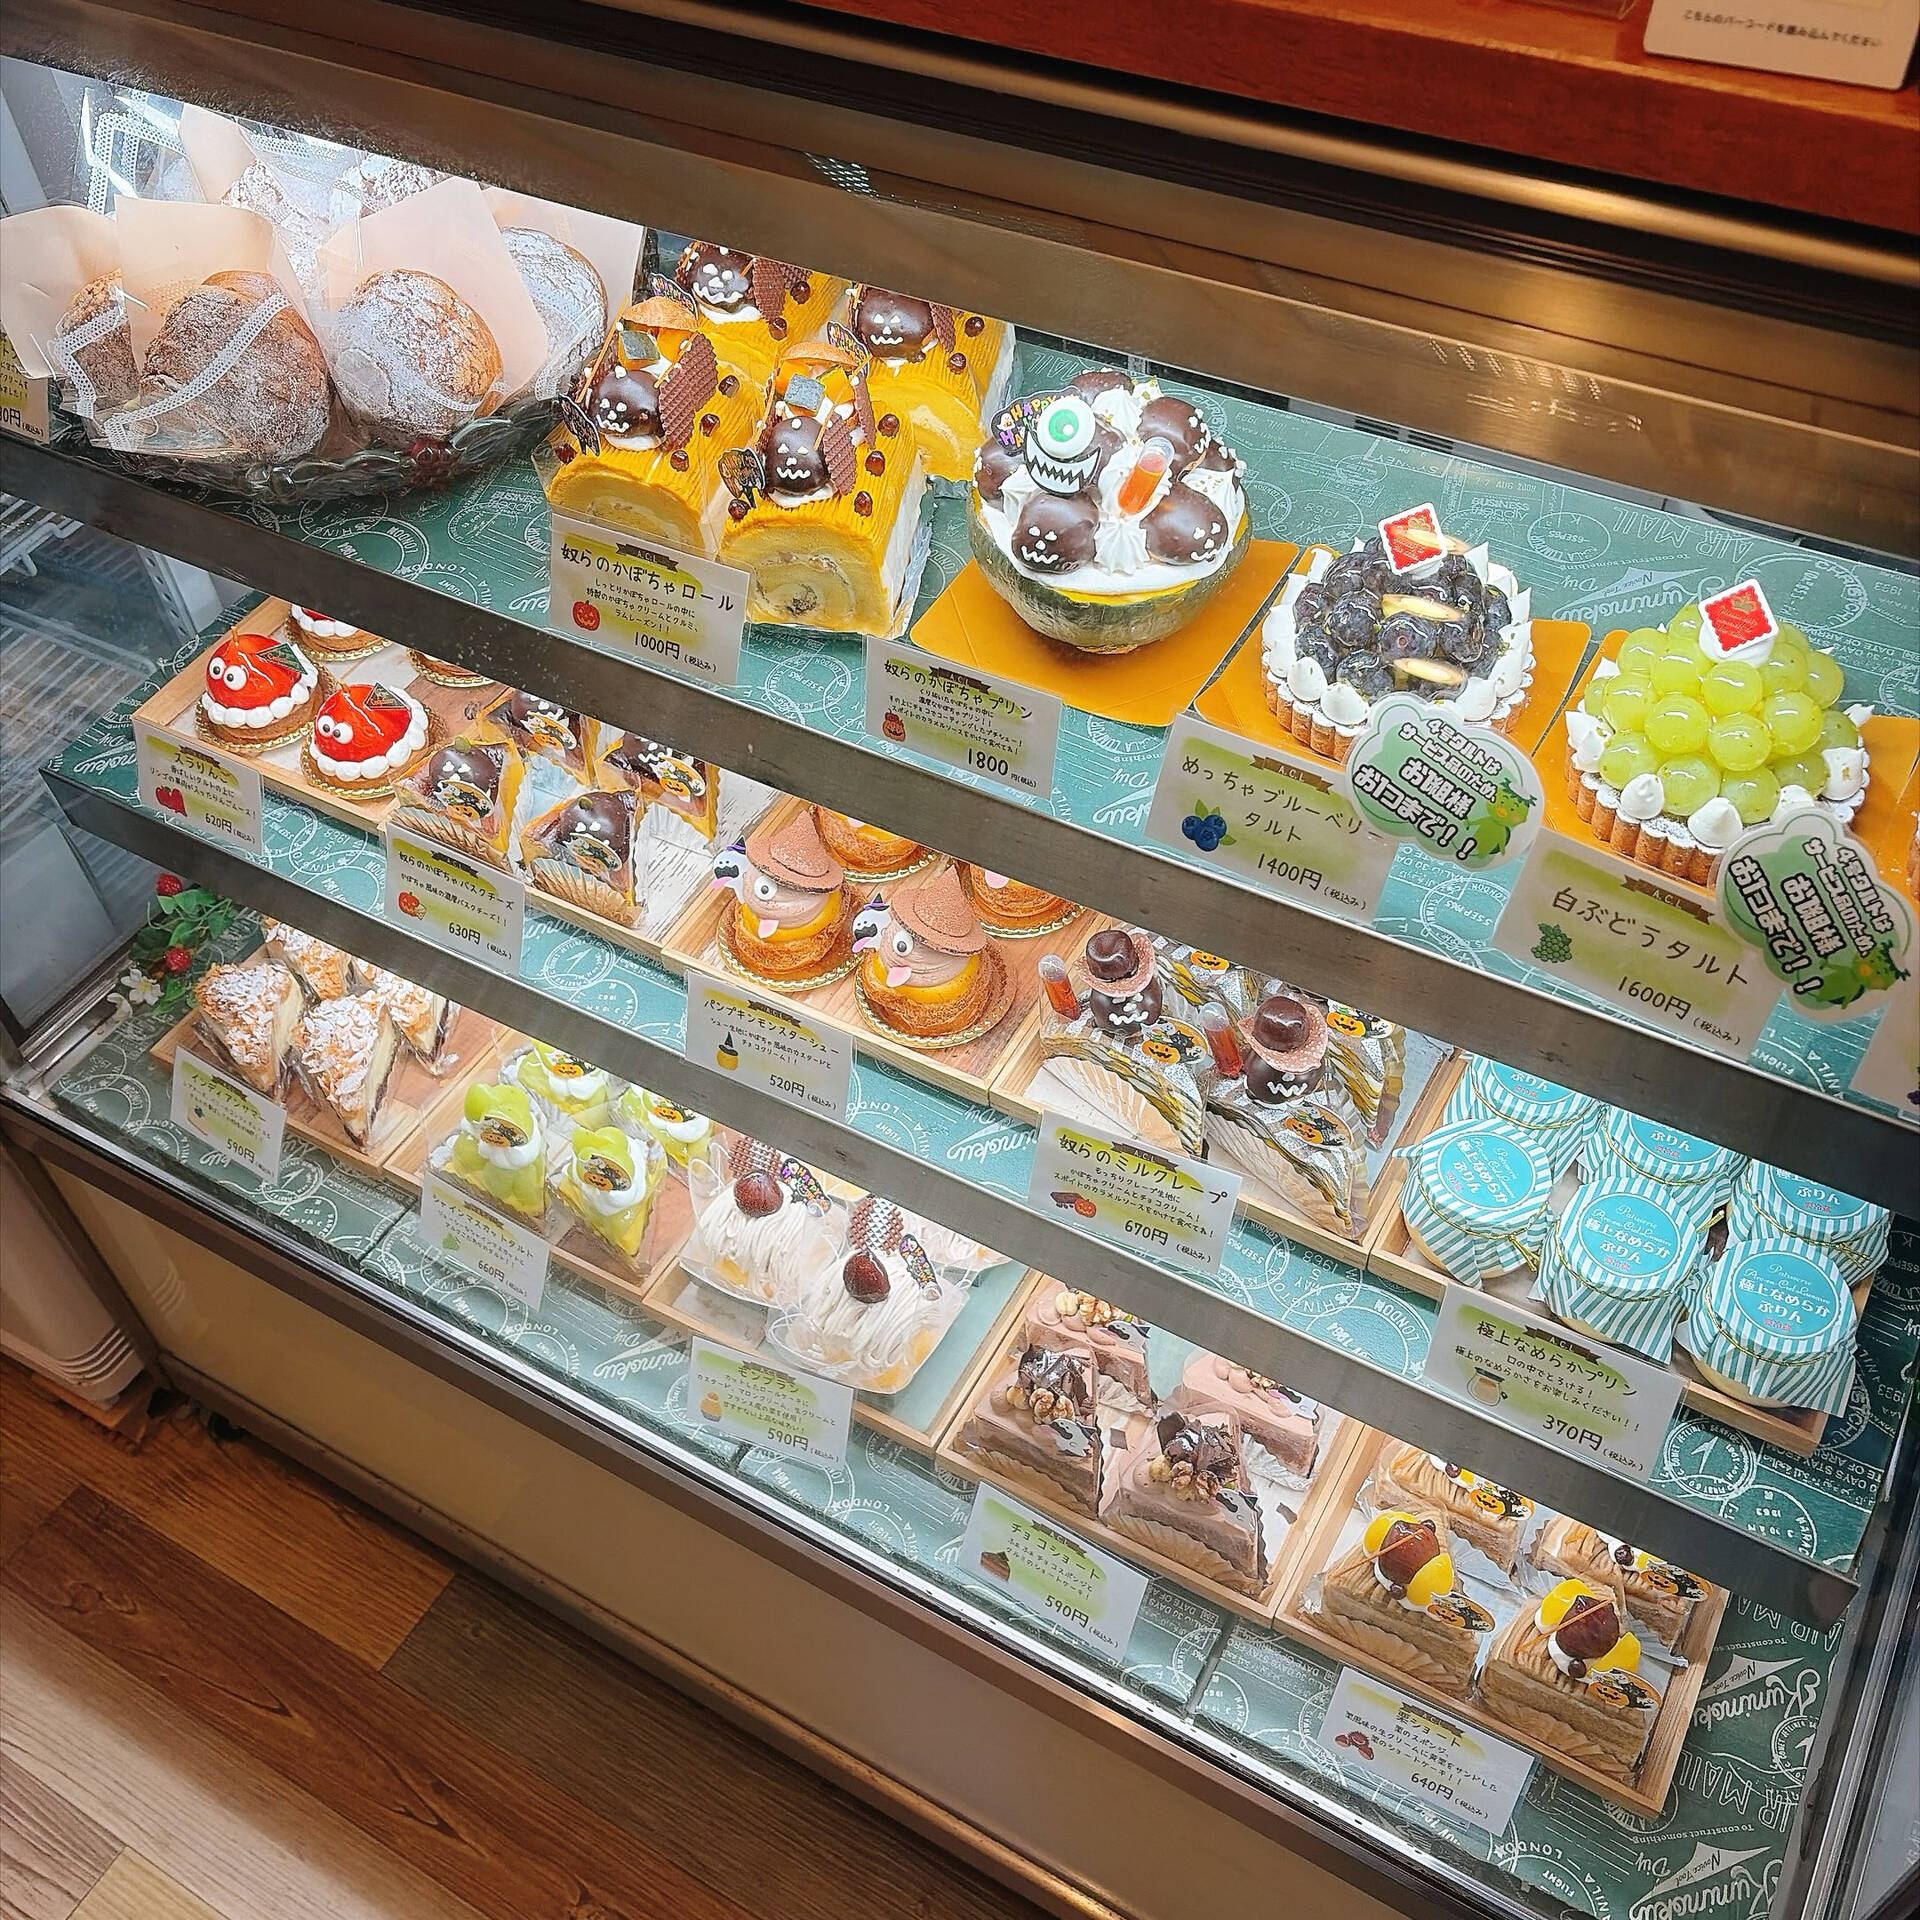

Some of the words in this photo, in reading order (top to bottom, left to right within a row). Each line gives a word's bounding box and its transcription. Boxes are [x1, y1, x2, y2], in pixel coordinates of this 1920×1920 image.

[1612, 506, 1689, 549] MAIL
[561, 543, 734, 611] 奴らのかぼちゃロール
[1560, 574, 1598, 592] Diy
[594, 578, 696, 619] しっとりかぼちゃロールの中に
[634, 632, 680, 660] 1000円
[884, 660, 1033, 719] 奴らのかぼちゃプリン
[967, 748, 1009, 776] 1800
[1398, 722, 1498, 804] サービス品のため、
[1426, 718, 1503, 777] 4号タルトは
[175, 752, 230, 784] スラりんご
[1182, 755, 1385, 840] めっちゃブルーベリー
[205, 813, 232, 833] 620円
[1244, 811, 1302, 844] タルト
[399, 851, 515, 911] 奴らのかぼちゃバスクチーズ
[1257, 853, 1322, 891] 1400円
[449, 922, 481, 945] 630円
[1552, 886, 1748, 987] 白ぶどうタルト
[1618, 975, 1692, 1021] 1600円
[704, 999, 840, 1054] パンプキンモンスターシュー
[769, 1074, 805, 1098] 520円
[227, 1139, 255, 1163] 590円
[1058, 1134, 1228, 1204] 奴らのミルクレープ
[1095, 1166, 1180, 1204] もっちりクレープ生地に
[1124, 1220, 1169, 1246] 670円
[1584, 1217, 1672, 1261] 極上なめらか
[478, 1260, 505, 1282] 660円
[1737, 1277, 1832, 1318] 極上なめらか
[1476, 1321, 1637, 1397] 極上なめらかプリン
[1506, 1354, 1594, 1399] 口の中でとろける！
[738, 1365, 800, 1393] モンブラン
[768, 1428, 808, 1452] 590円
[1542, 1415, 1603, 1452] 370円
[1011, 1522, 1100, 1581] チョコショート
[1045, 1595, 1089, 1629] 590円
[1396, 1711, 1461, 1749] 栗ショート
[1411, 1773, 1454, 1801] 640円
